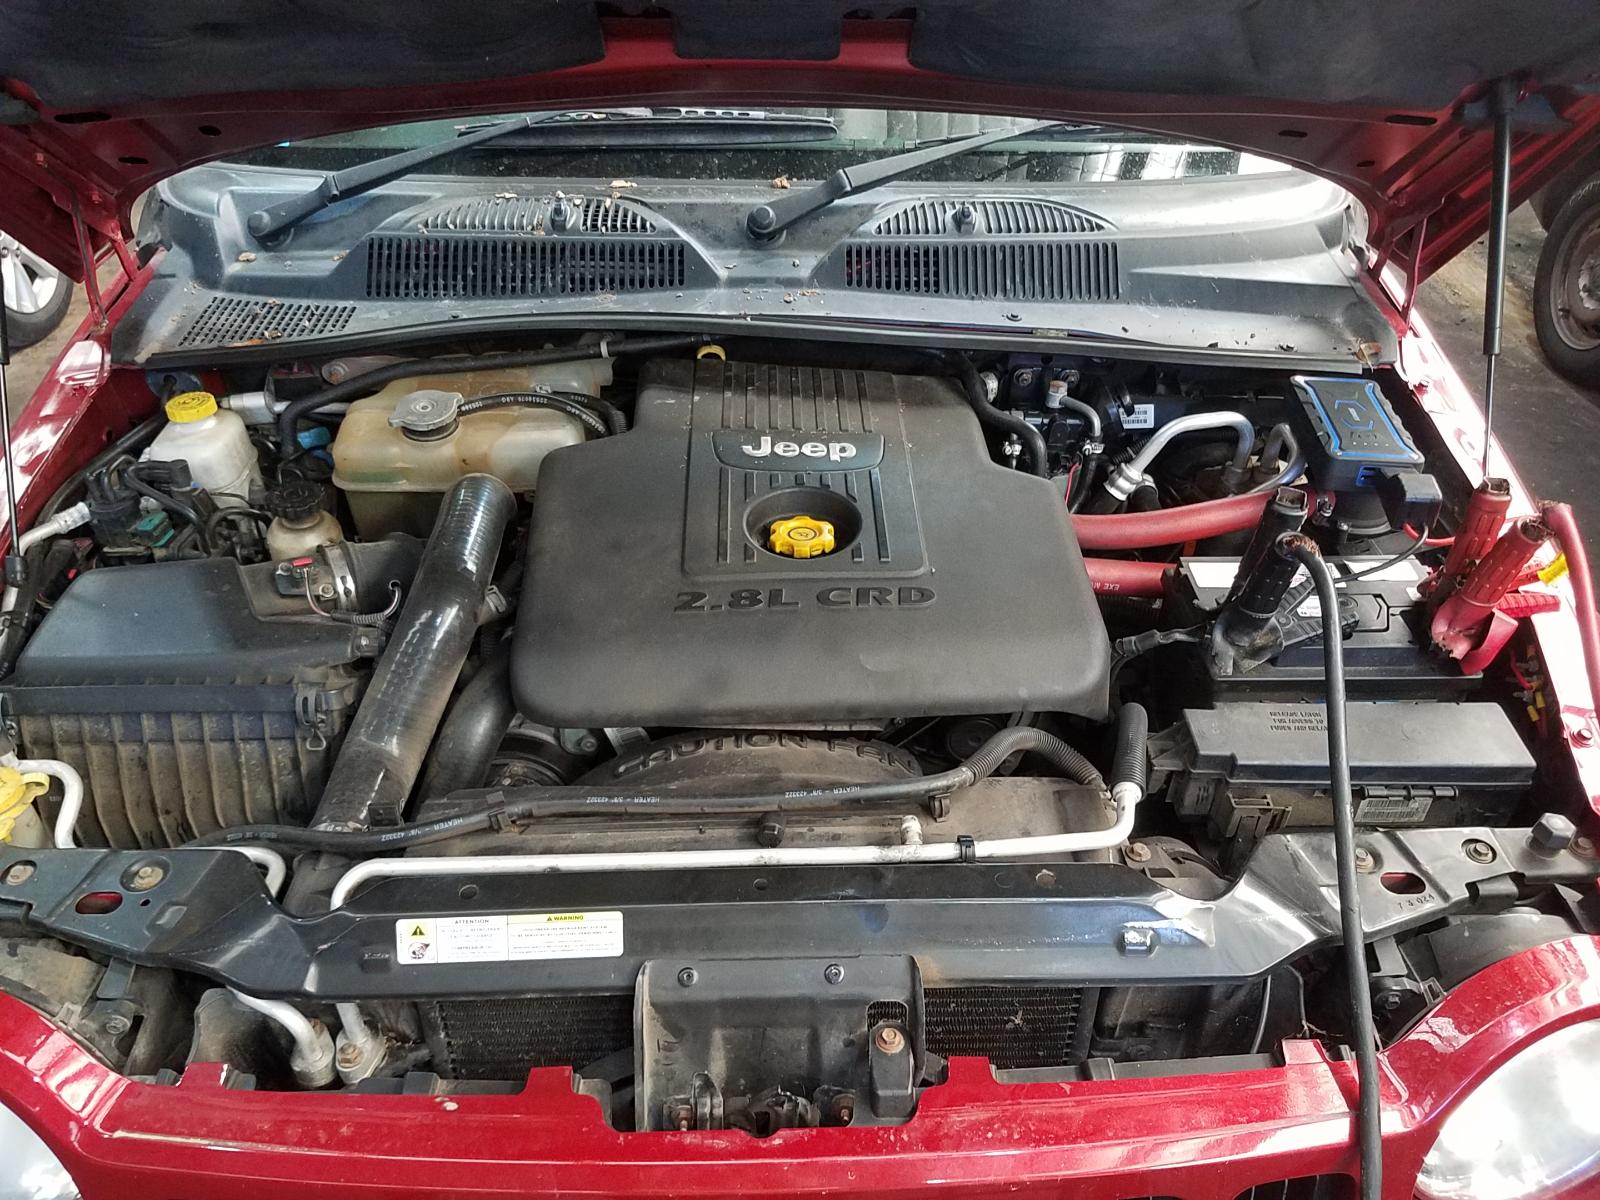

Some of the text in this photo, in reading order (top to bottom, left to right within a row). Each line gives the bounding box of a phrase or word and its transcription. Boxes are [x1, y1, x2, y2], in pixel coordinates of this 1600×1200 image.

[742, 436, 857, 463] Jeep
[674, 586, 936, 612] 2.8L CRD
[616, 732, 916, 777] CAUTION FAN
[634, 796, 660, 804] HEATER
[833, 785, 859, 795] HEATER
[433, 817, 463, 831] HEATER
